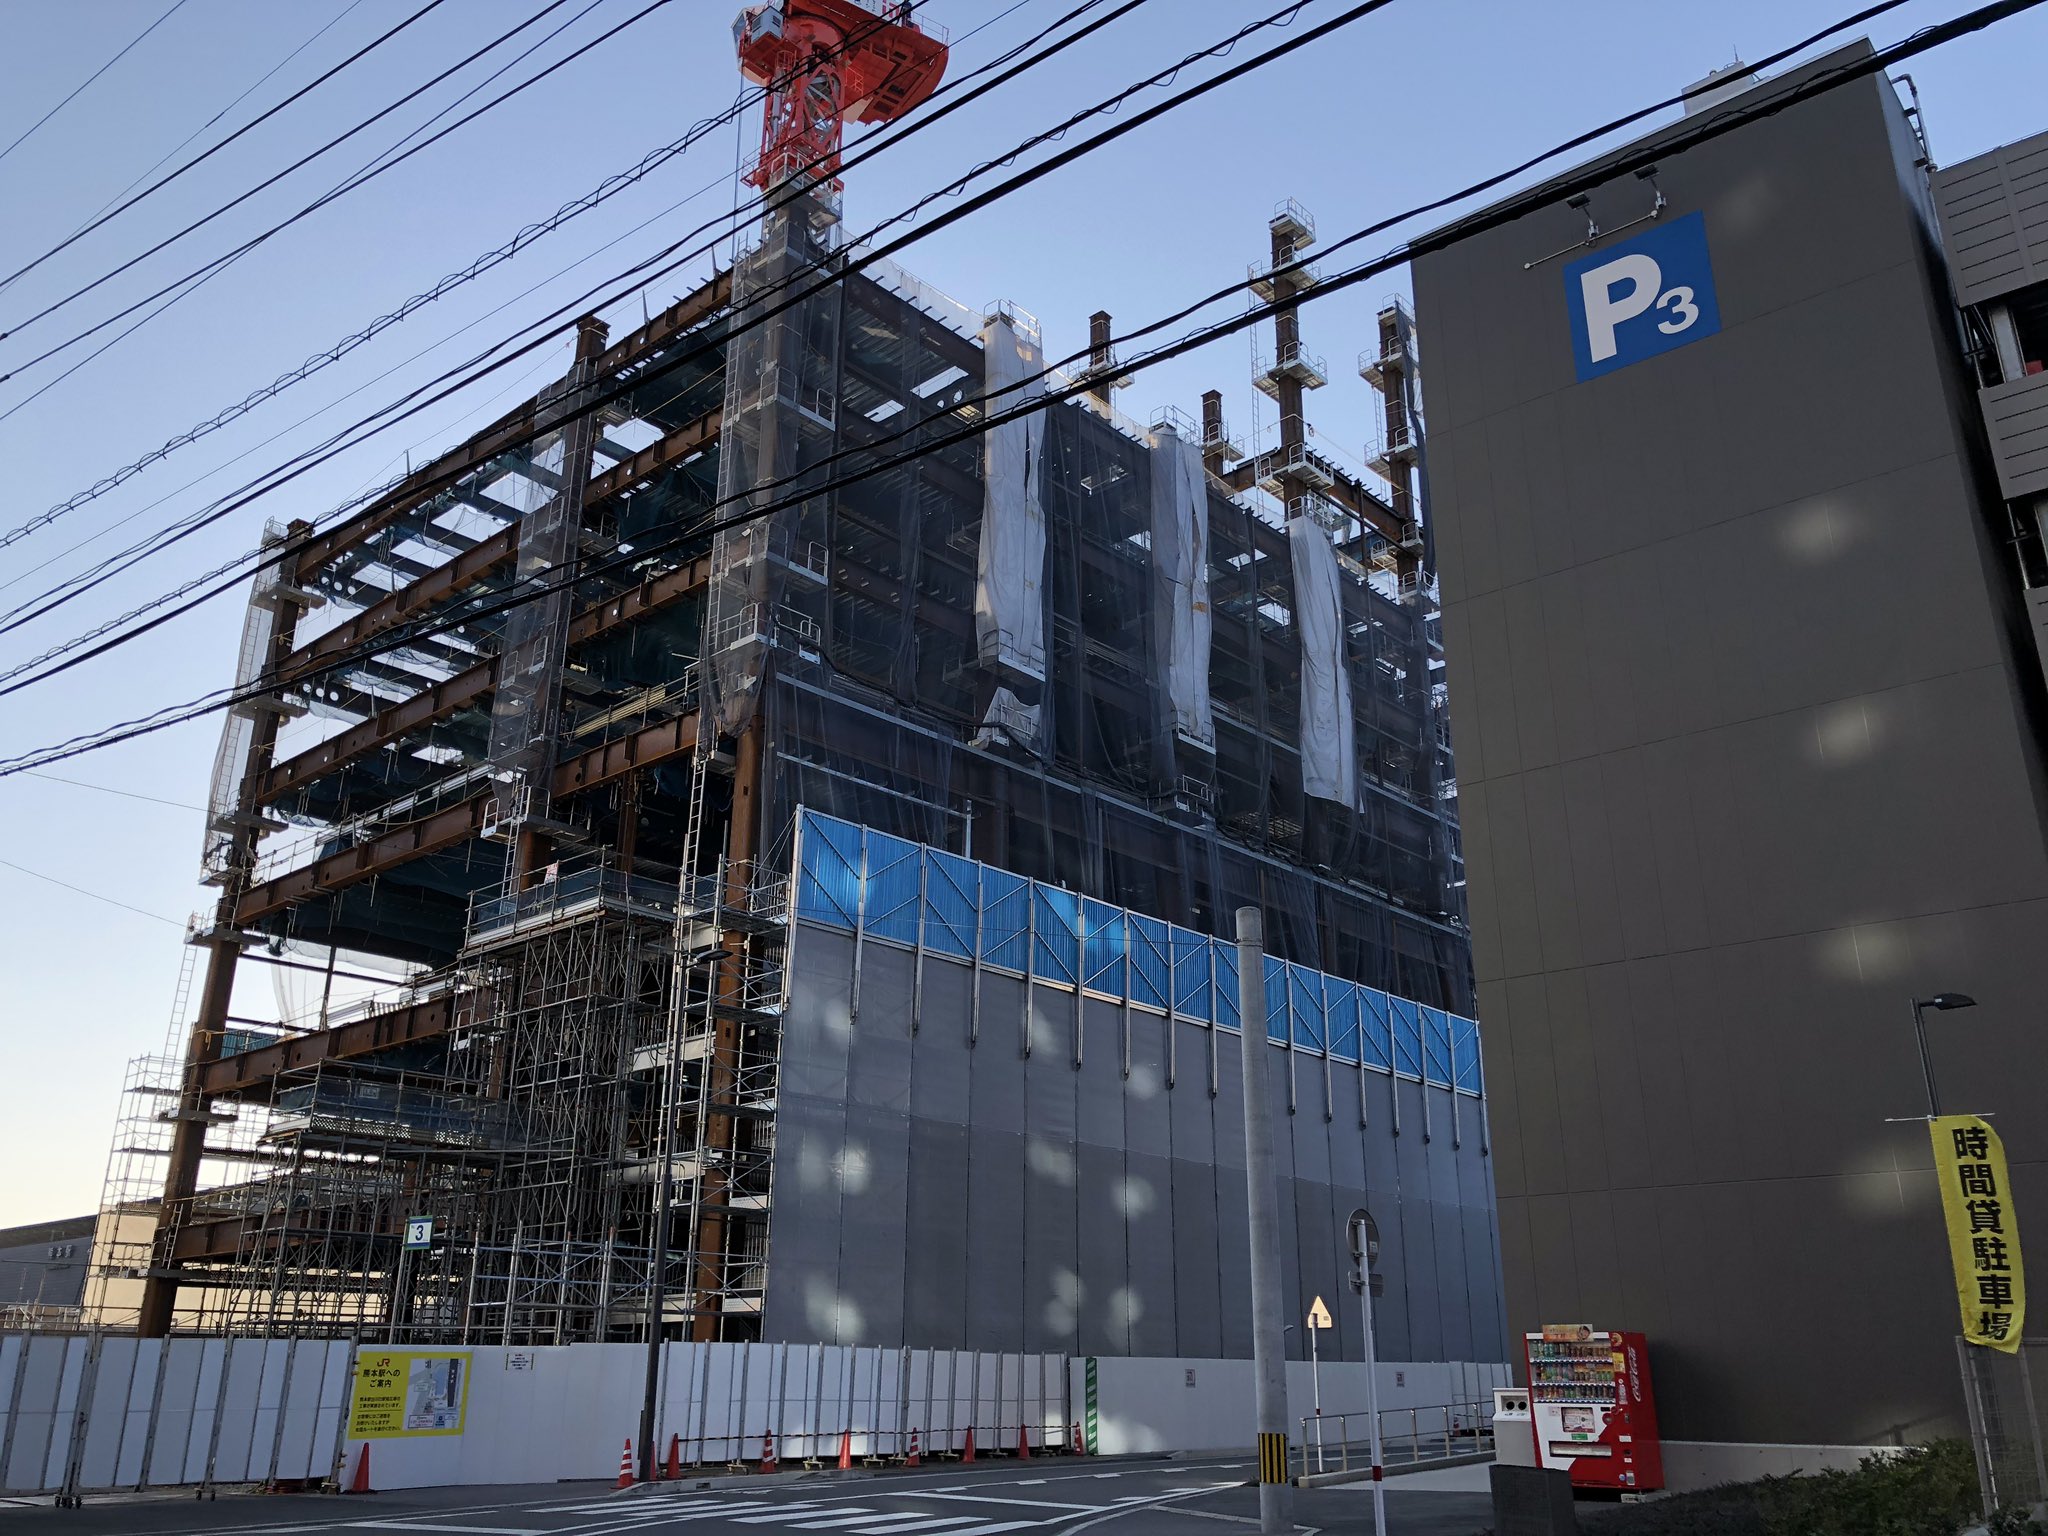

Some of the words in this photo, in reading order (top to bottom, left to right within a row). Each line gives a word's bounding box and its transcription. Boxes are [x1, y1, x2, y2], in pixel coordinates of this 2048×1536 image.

[415, 1224, 424, 1241] 3
[1951, 1126, 2015, 1342] 時間貸駐車場
[376, 1358, 391, 1367] JR
[362, 1368, 401, 1378] 熊本駅への
[369, 1379, 392, 1388] ご案内
